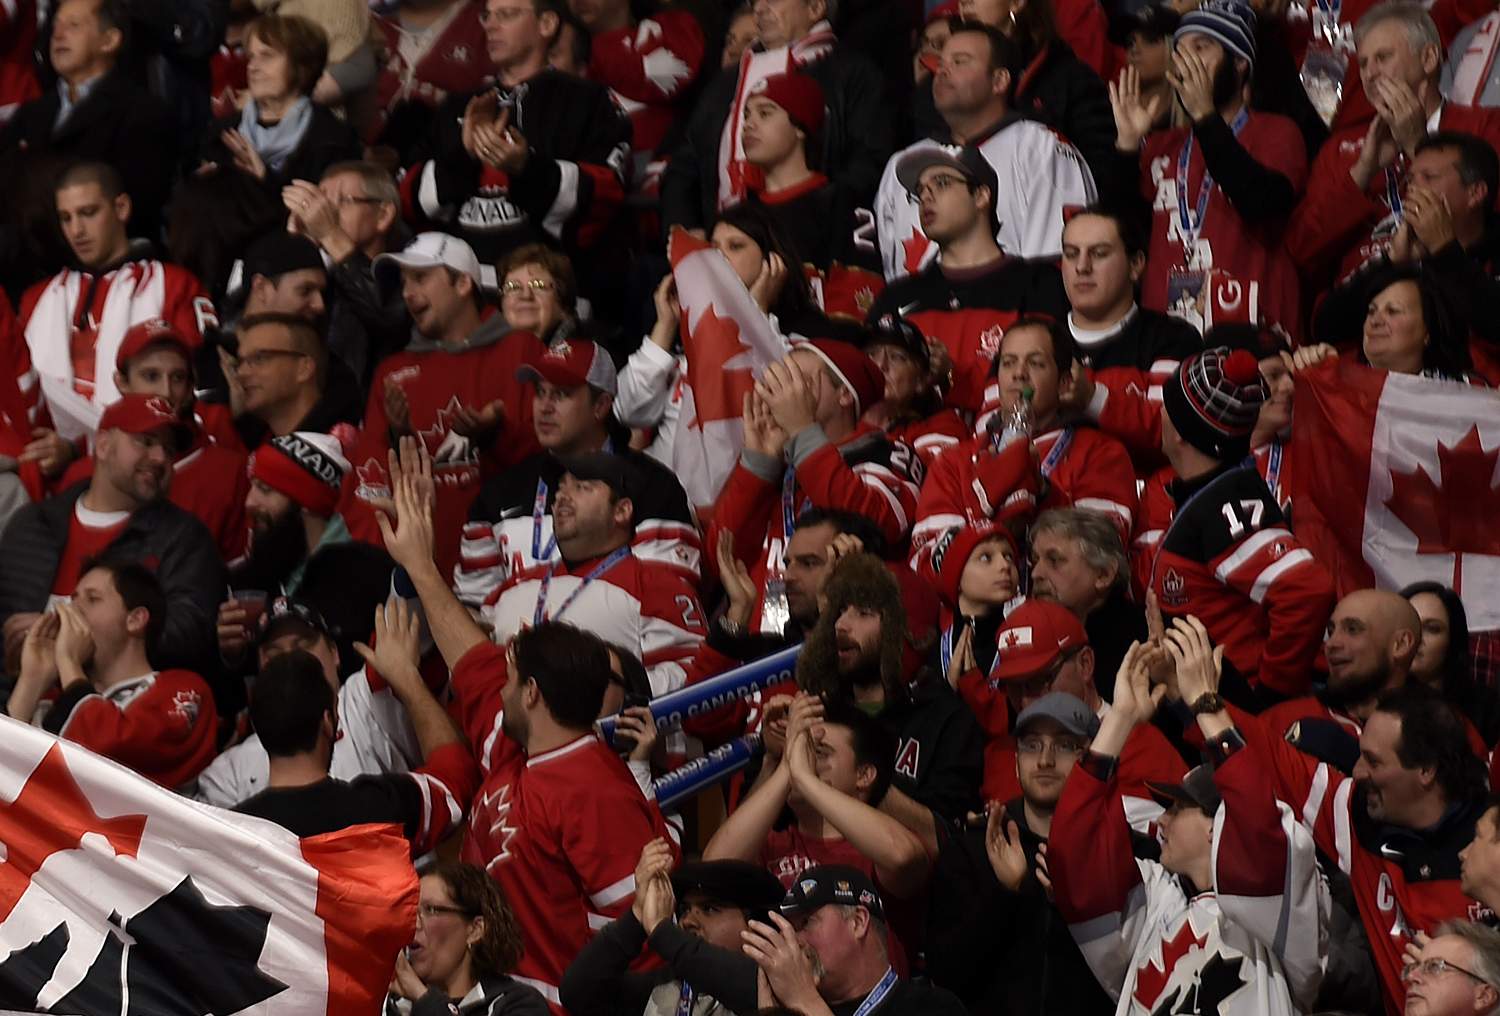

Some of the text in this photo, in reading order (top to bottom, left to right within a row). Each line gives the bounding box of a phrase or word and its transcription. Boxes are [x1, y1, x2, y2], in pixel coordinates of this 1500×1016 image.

[1222, 499, 1265, 541] 17
[655, 667, 793, 730] GO CANADA GO
